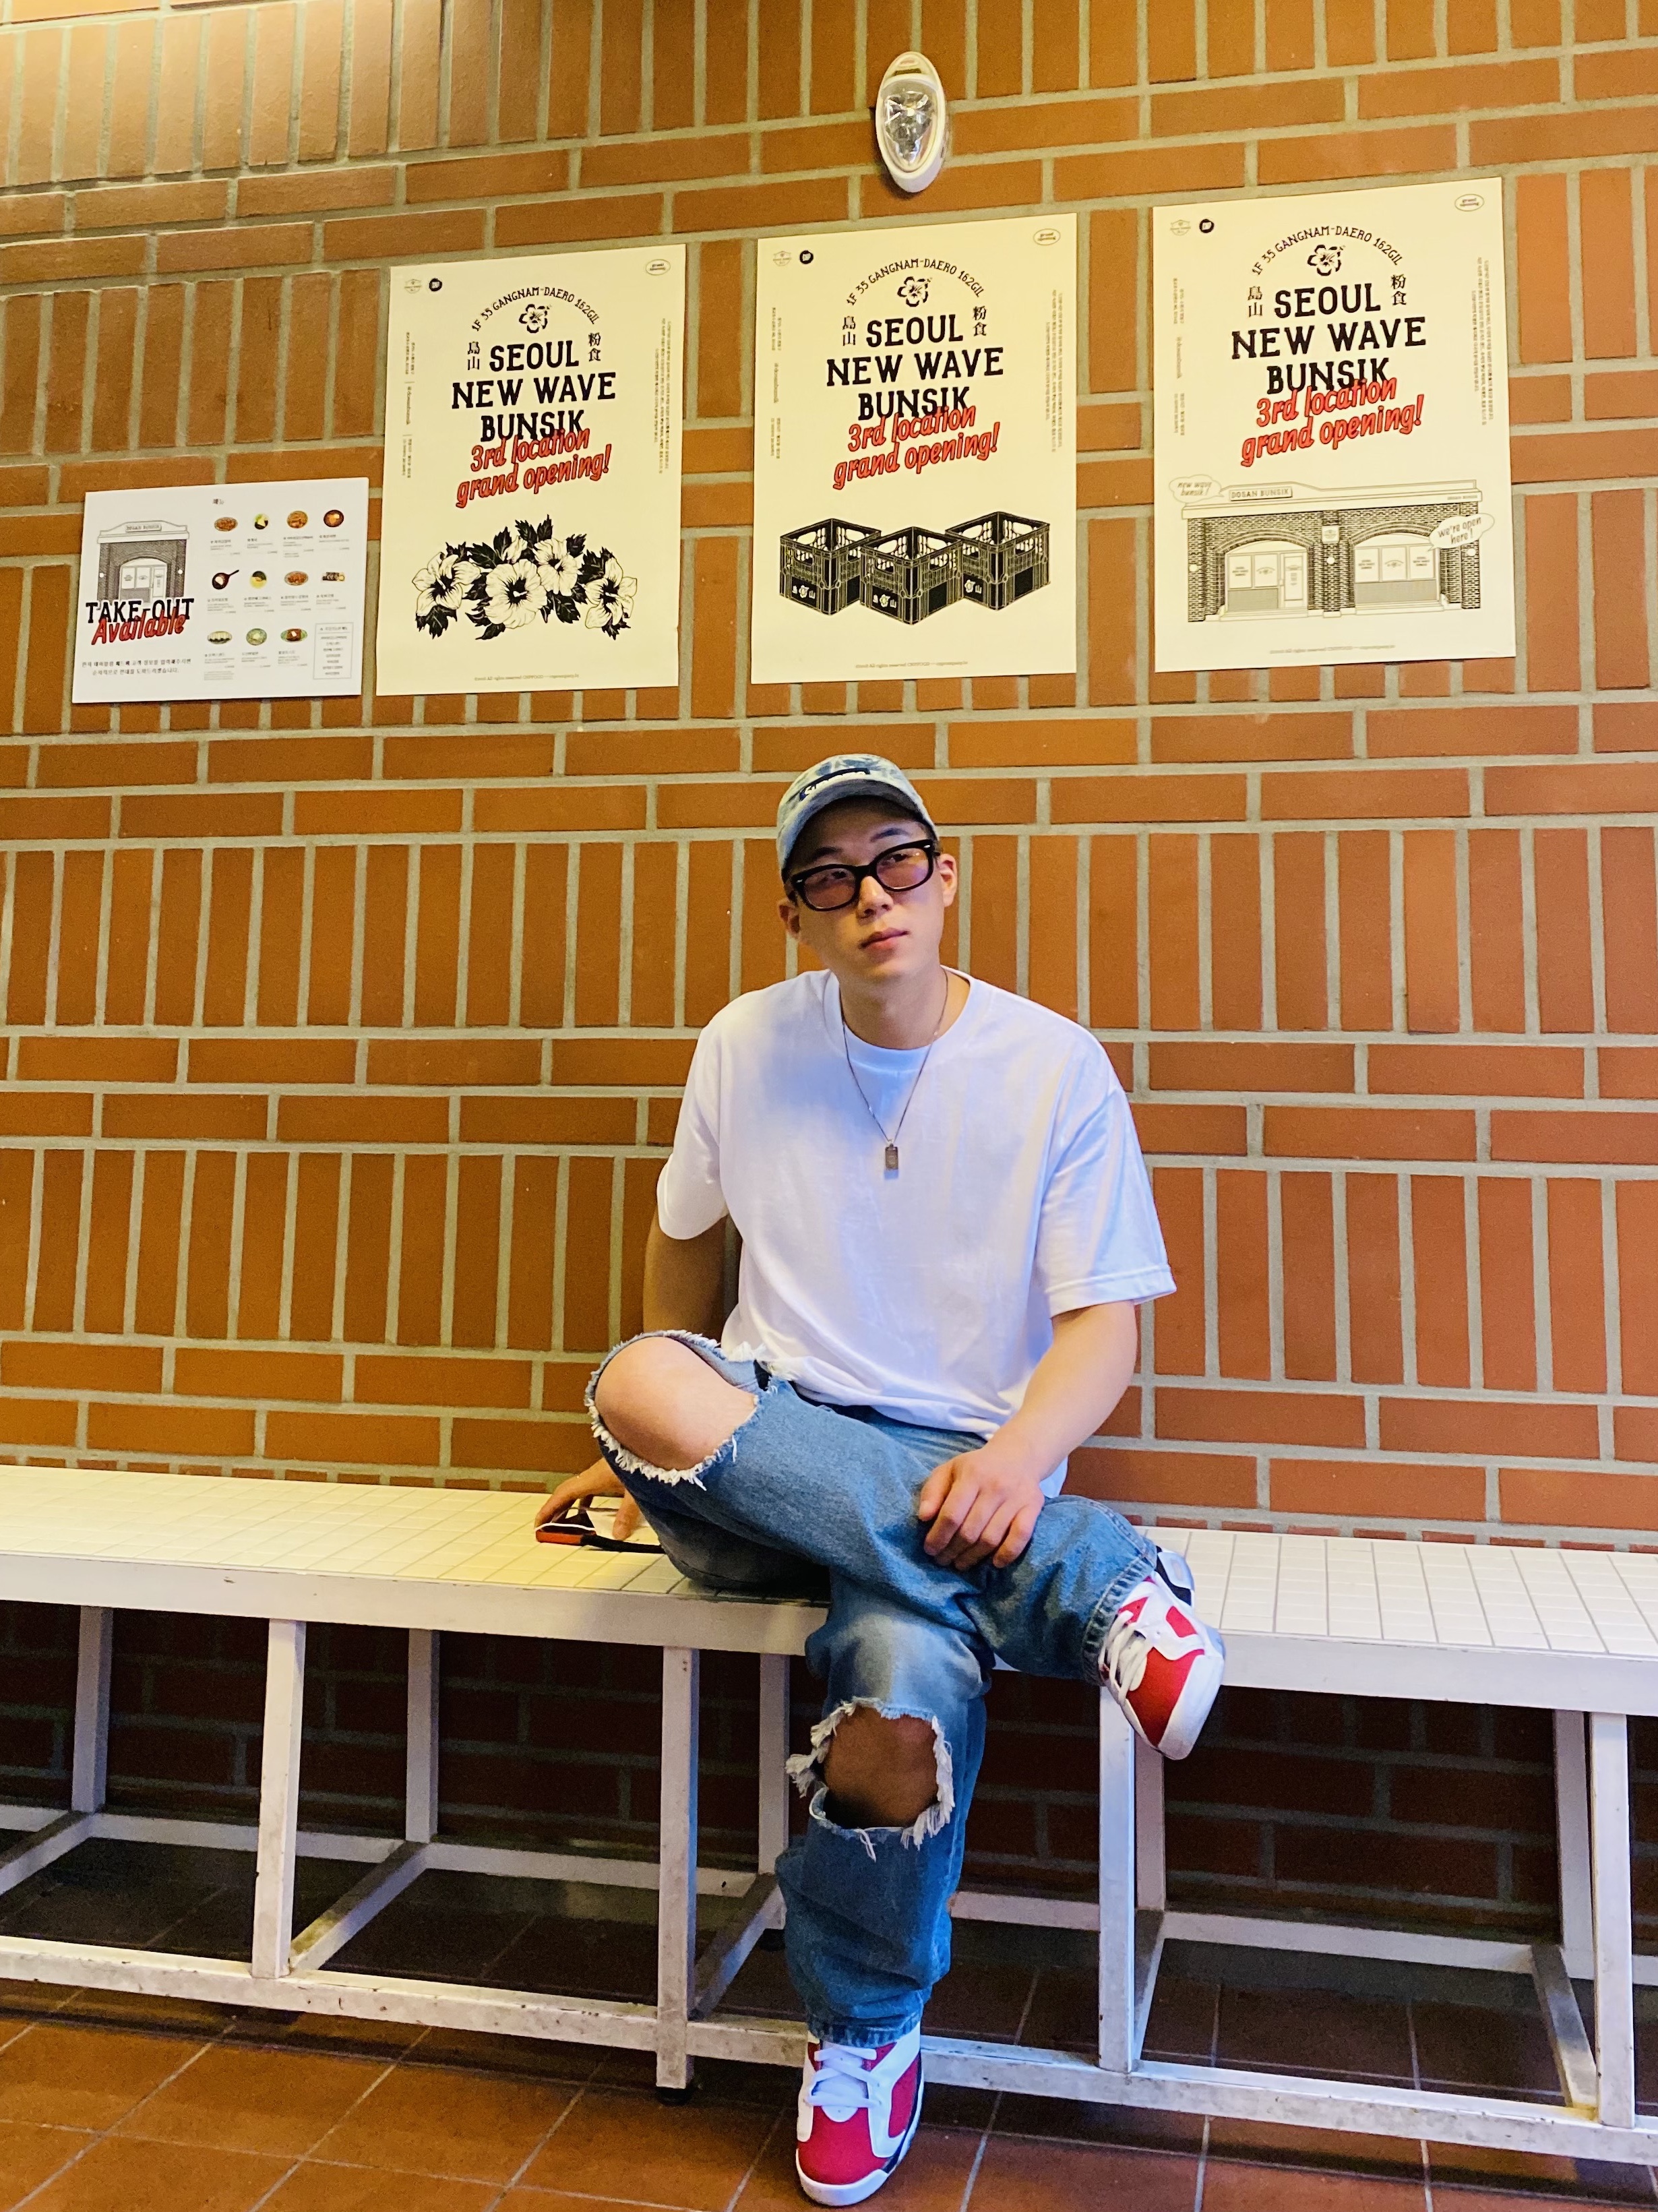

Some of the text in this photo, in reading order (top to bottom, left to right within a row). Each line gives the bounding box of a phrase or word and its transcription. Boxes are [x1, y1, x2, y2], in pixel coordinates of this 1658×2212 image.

[1262, 249, 1276, 264] 35
[1275, 226, 1372, 252] GANGNAM-DAERO
[1373, 238, 1403, 266] 162GIL
[856, 280, 869, 294] 35
[868, 258, 957, 284] GANGNAM-DAERO
[957, 271, 984, 297] 162GIL
[493, 286, 575, 311] GANGNAM-DAERO
[574, 299, 599, 324] 162GIL
[1274, 283, 1381, 318] SEOUL
[866, 314, 963, 347] SEOUL
[1231, 317, 1426, 359] NEW WAVE
[489, 340, 579, 371] SEOUL
[827, 347, 1003, 386] NEW WAVE
[452, 372, 616, 409] NEW WAVE
[1266, 357, 1389, 394] BUNSIK
[858, 386, 969, 421] BUNSIK
[1256, 377, 1397, 427] 3rd location
[481, 410, 584, 442] BUNSIK
[848, 406, 976, 452] 3rd location
[1241, 394, 1424, 467] grand opening!
[470, 428, 590, 472] 3rd location
[832, 422, 1000, 490] grand opening!
[456, 443, 611, 508] grand opening!
[1231, 490, 1258, 499] DOSAN
[1462, 517, 1481, 531] open
[86, 598, 194, 623] TAKE-OUT
[91, 606, 186, 645] Available
